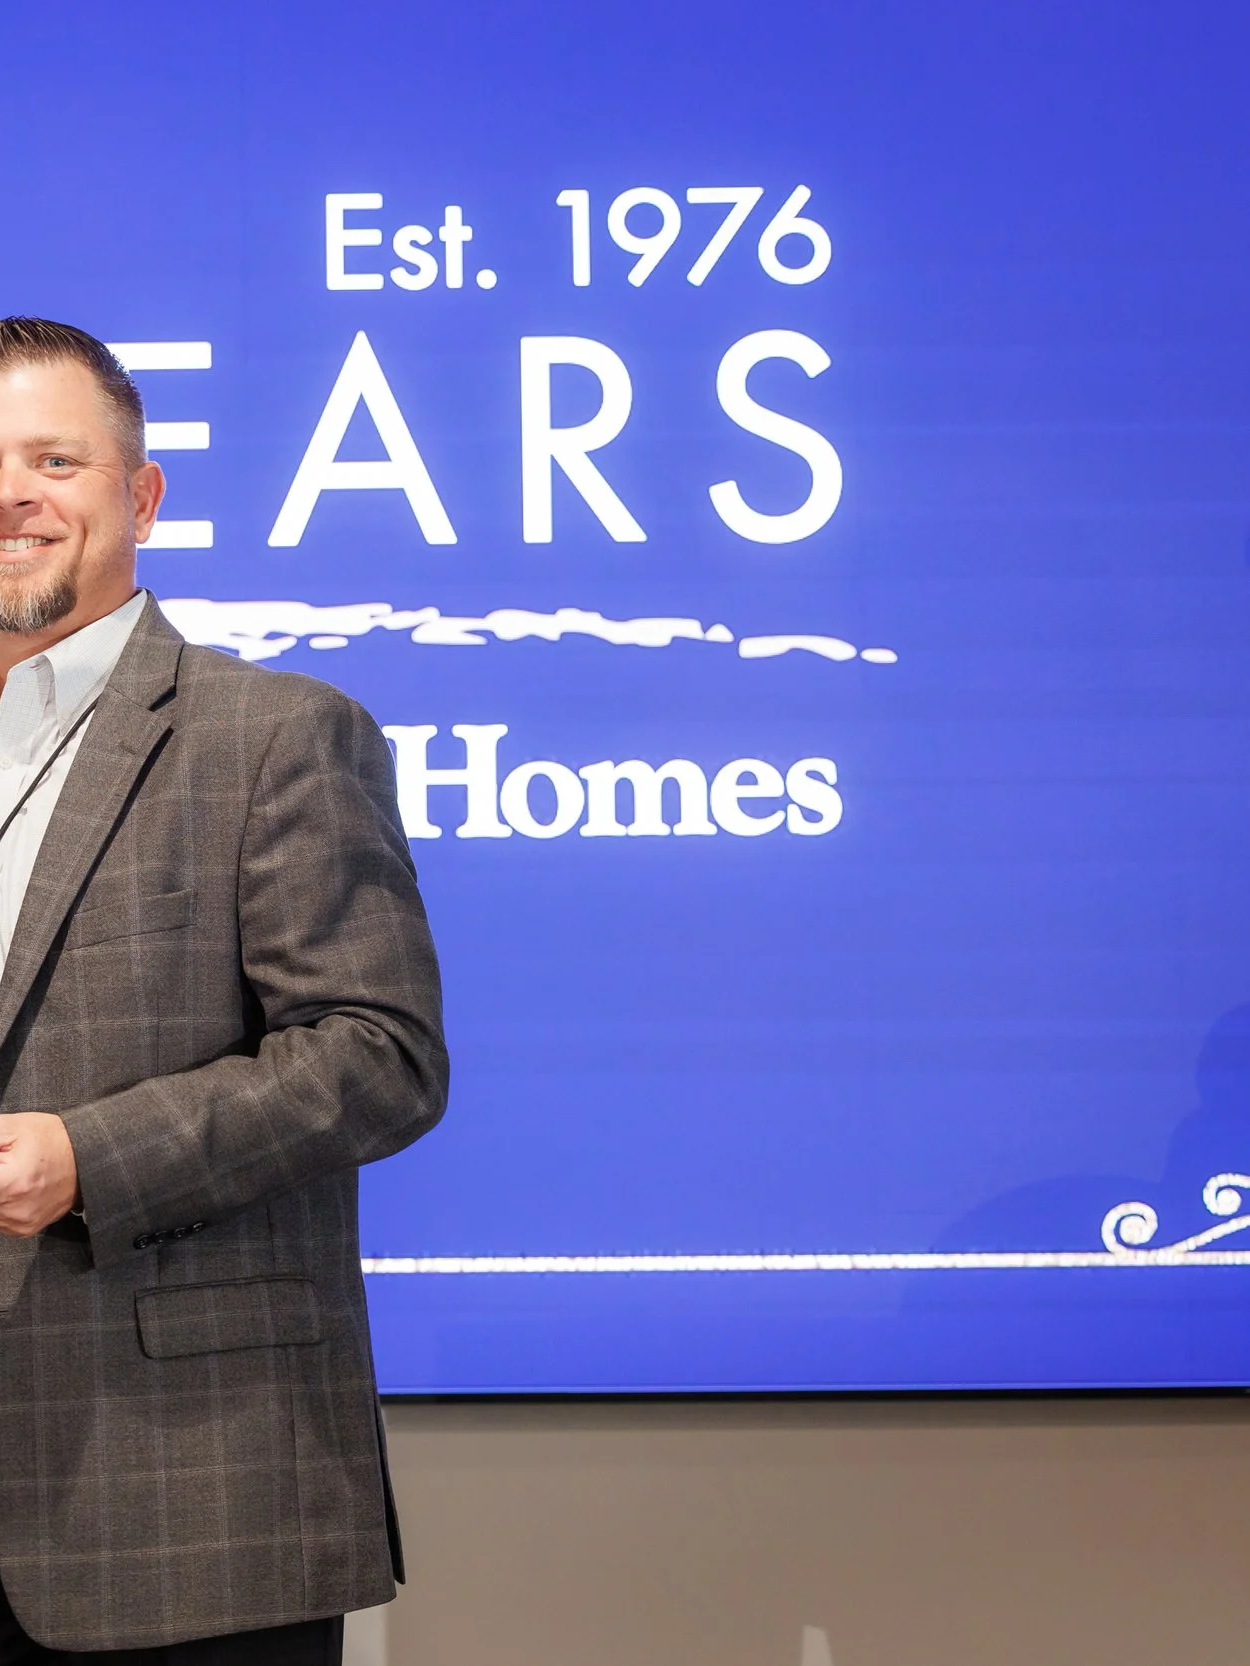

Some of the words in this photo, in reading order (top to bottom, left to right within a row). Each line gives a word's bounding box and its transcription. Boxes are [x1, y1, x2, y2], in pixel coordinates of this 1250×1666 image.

[325, 193, 497, 291] Est.
[556, 186, 832, 288] 1976
[381, 724, 842, 837] Homes
